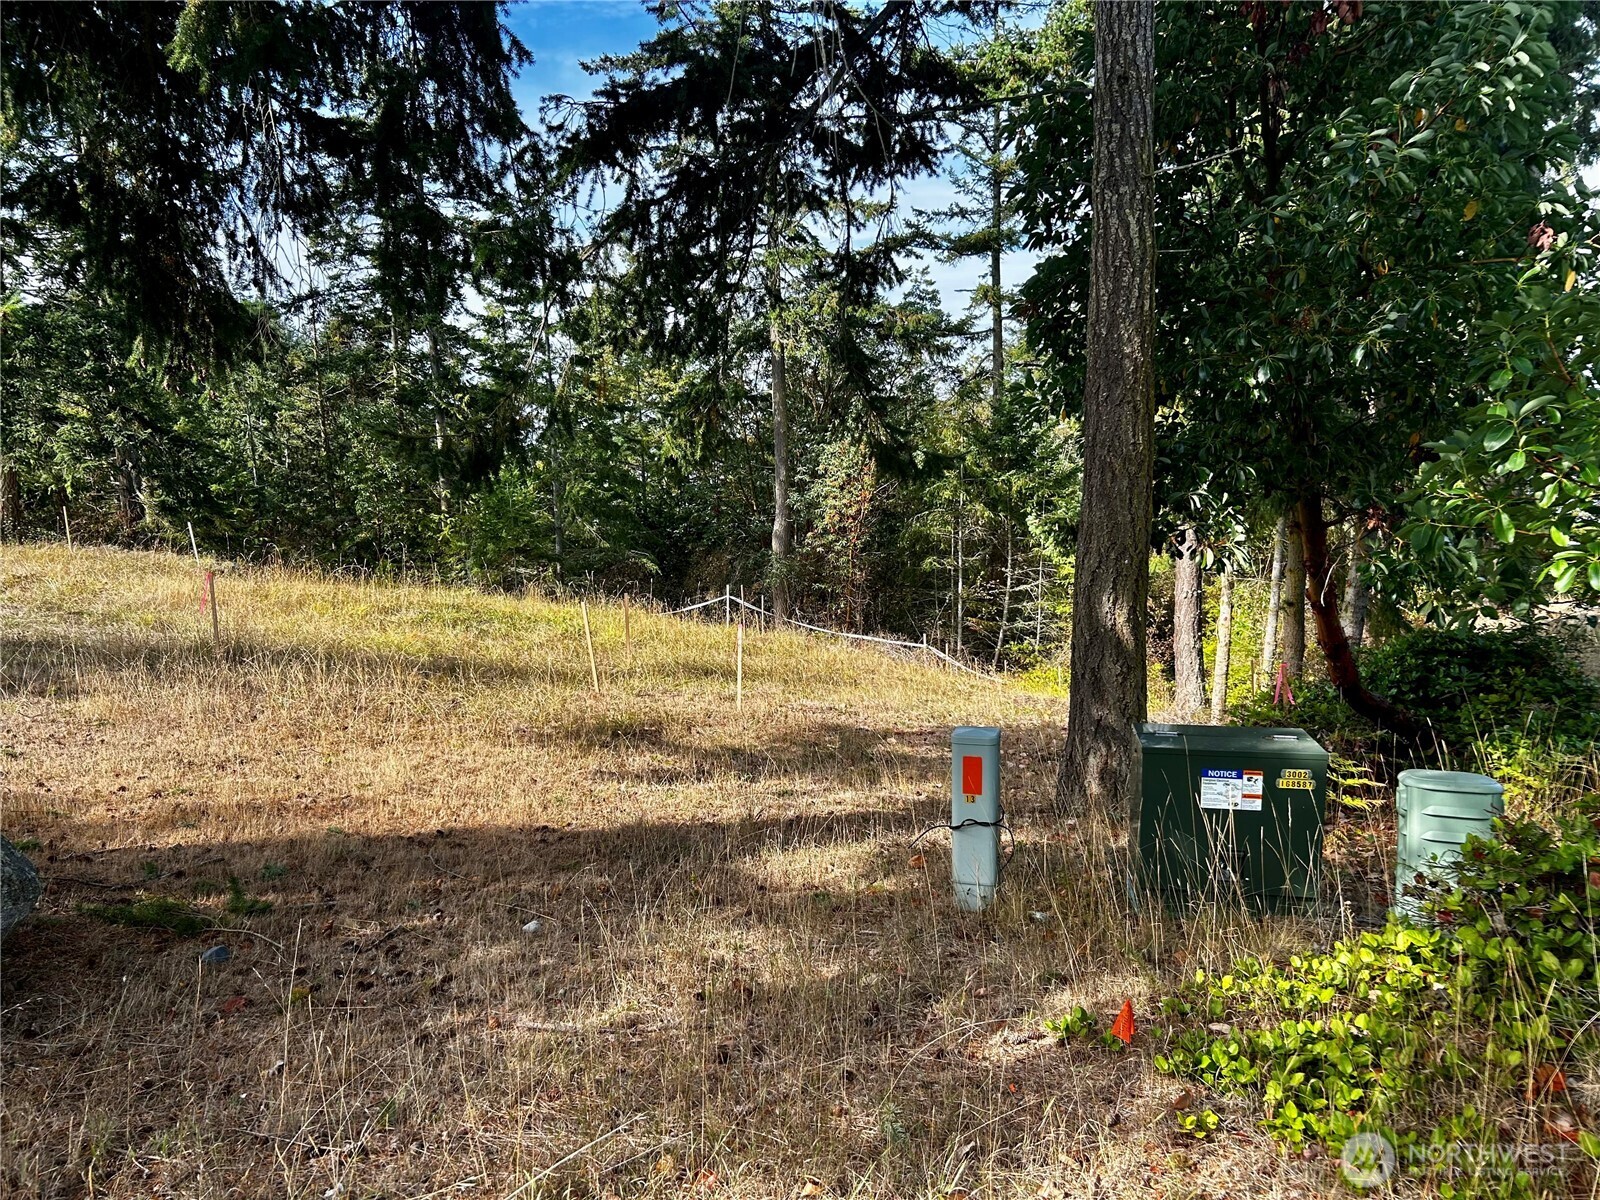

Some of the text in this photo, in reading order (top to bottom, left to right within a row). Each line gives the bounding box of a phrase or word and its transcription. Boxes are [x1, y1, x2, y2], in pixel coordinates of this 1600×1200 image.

[1208, 770, 1238, 778] NOTICE
[1286, 771, 1308, 779] 3002
[1281, 780, 1312, 788] 168587
[966, 795, 975, 803] 13
